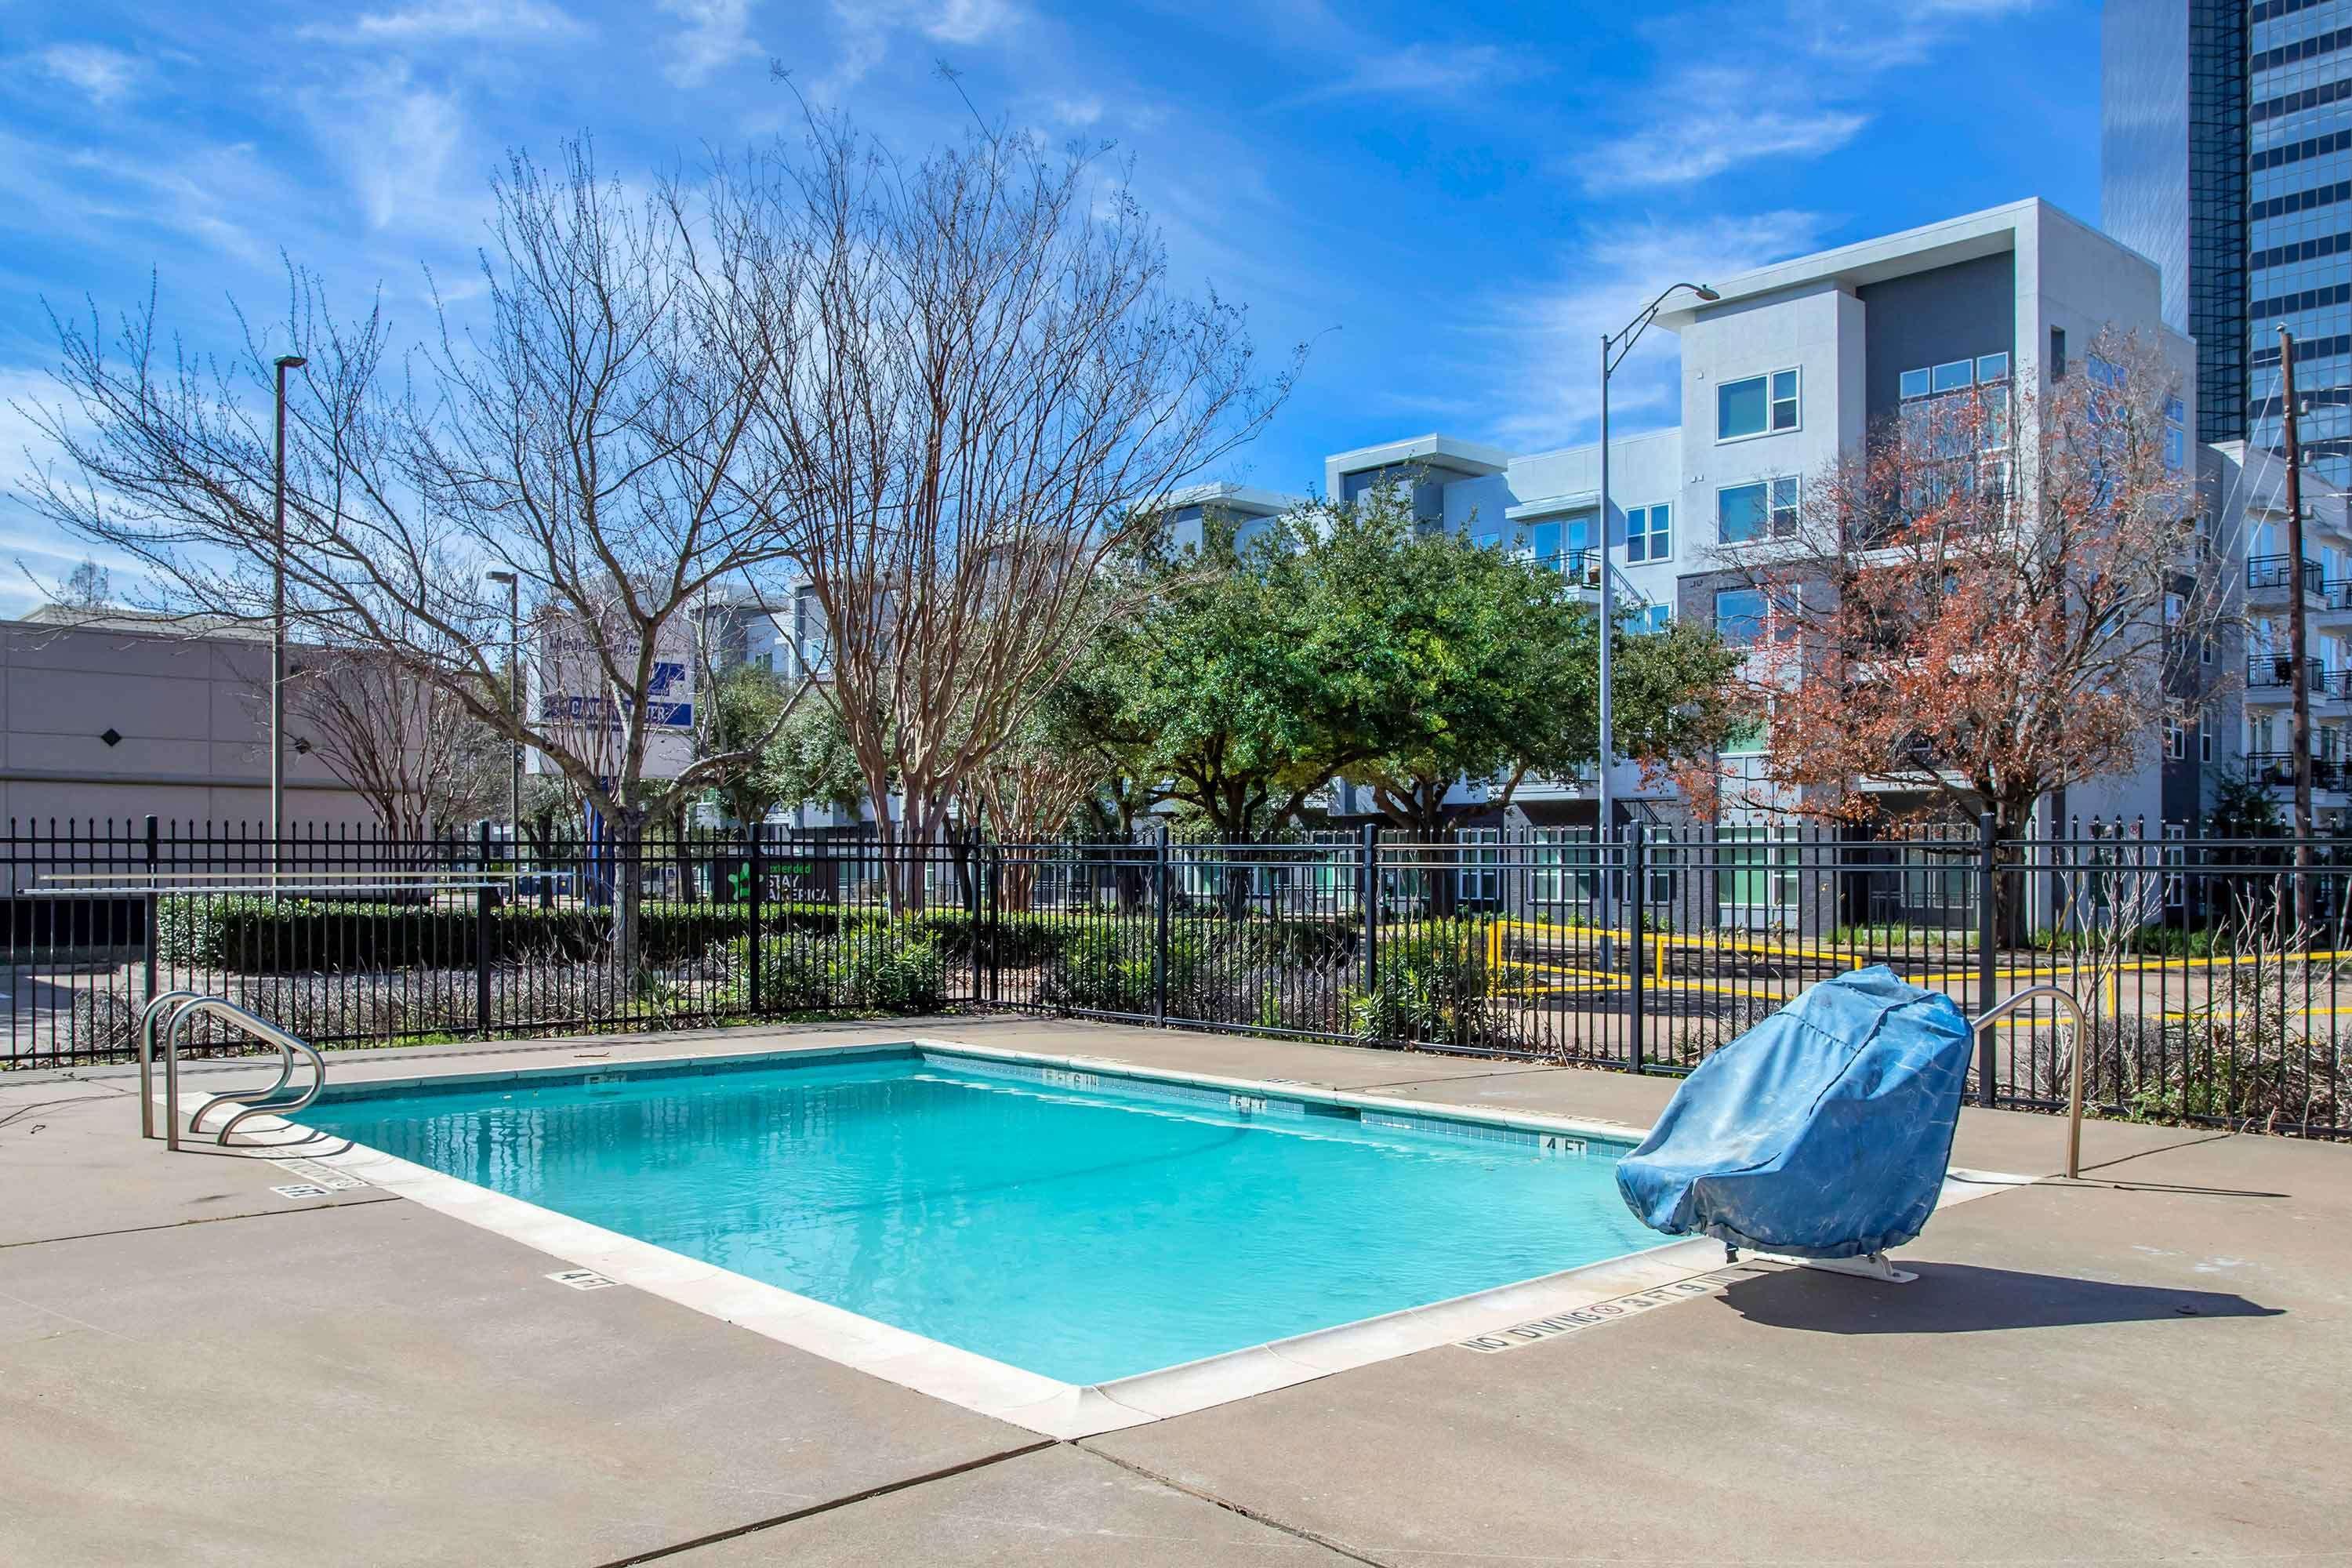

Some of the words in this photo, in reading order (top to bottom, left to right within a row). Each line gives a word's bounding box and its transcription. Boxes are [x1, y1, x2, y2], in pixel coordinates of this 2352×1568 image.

[768, 874, 799, 887] STAY
[1547, 1137, 1556, 1149] 4
[1565, 1138, 1585, 1152] FT
[571, 1278, 617, 1287] FT
[1459, 1337, 1509, 1352] NO
[1506, 1312, 1602, 1339] DIVING
[1621, 1298, 1654, 1308] 3
[1642, 1289, 1685, 1301] FT
